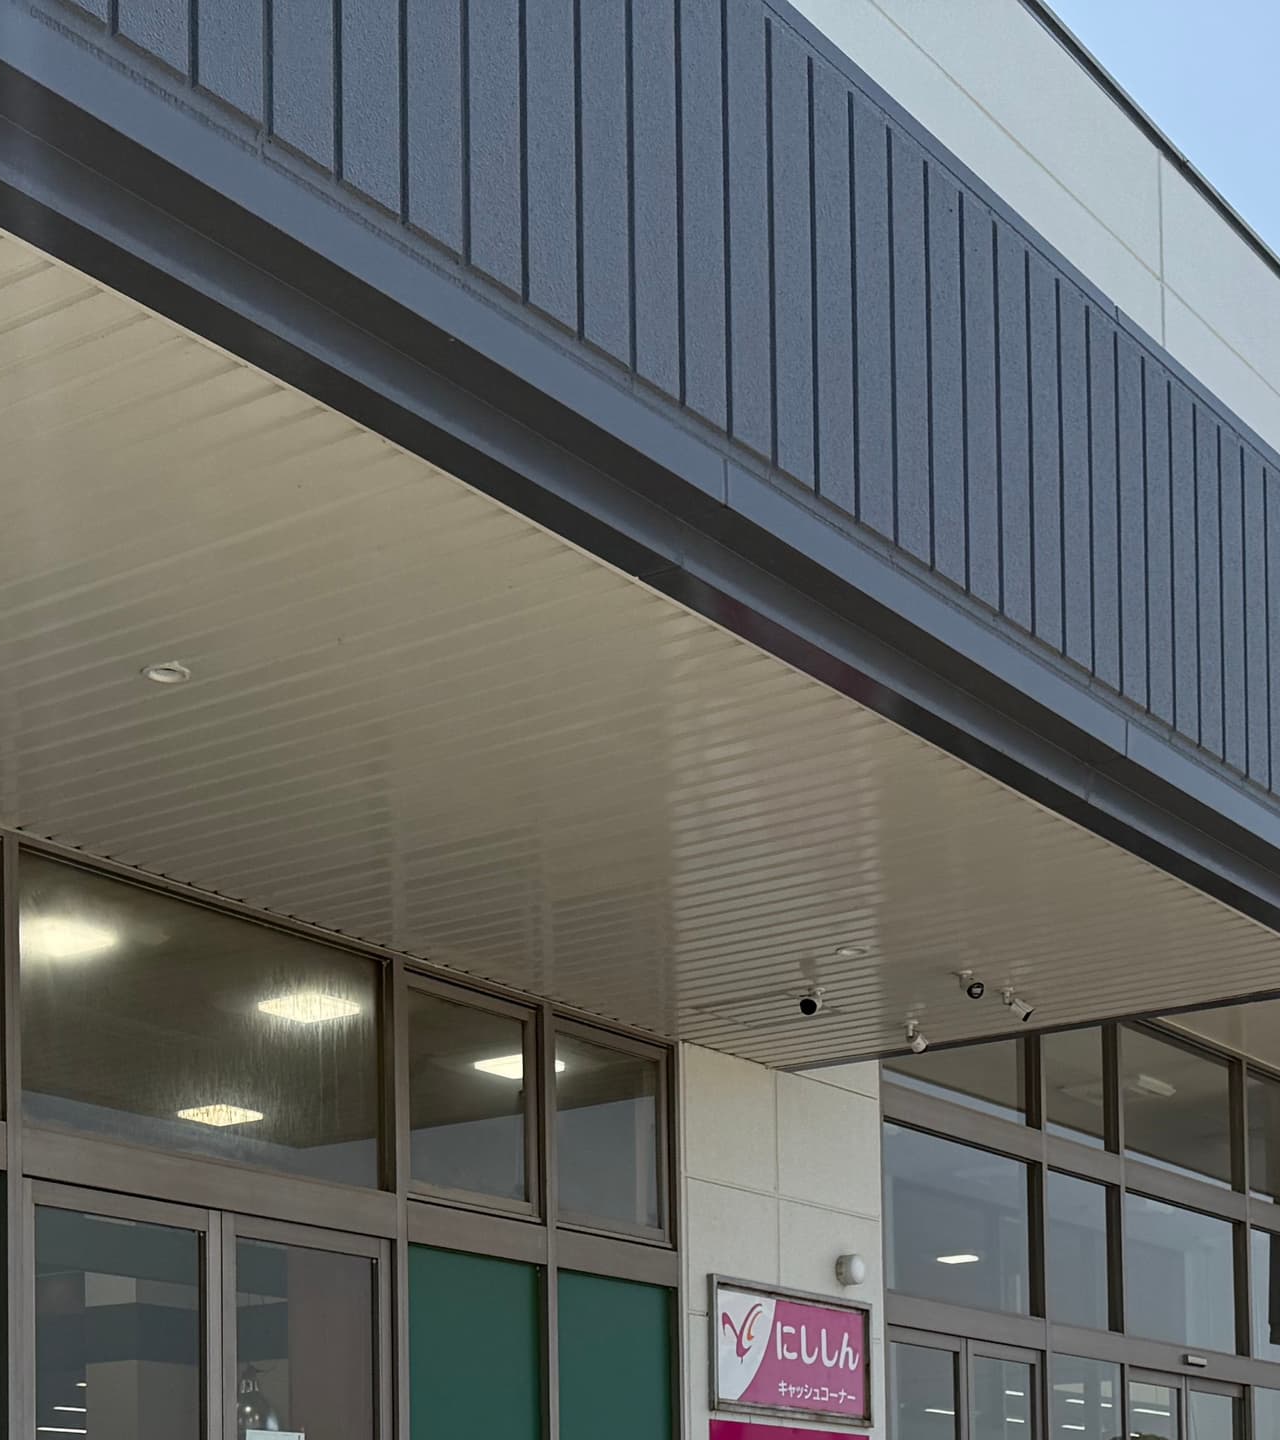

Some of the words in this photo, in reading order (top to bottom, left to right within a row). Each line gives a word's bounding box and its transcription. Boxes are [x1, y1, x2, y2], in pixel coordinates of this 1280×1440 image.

[776, 1320, 859, 1371] にししん
[778, 1379, 856, 1404] キャッシュコーナー
